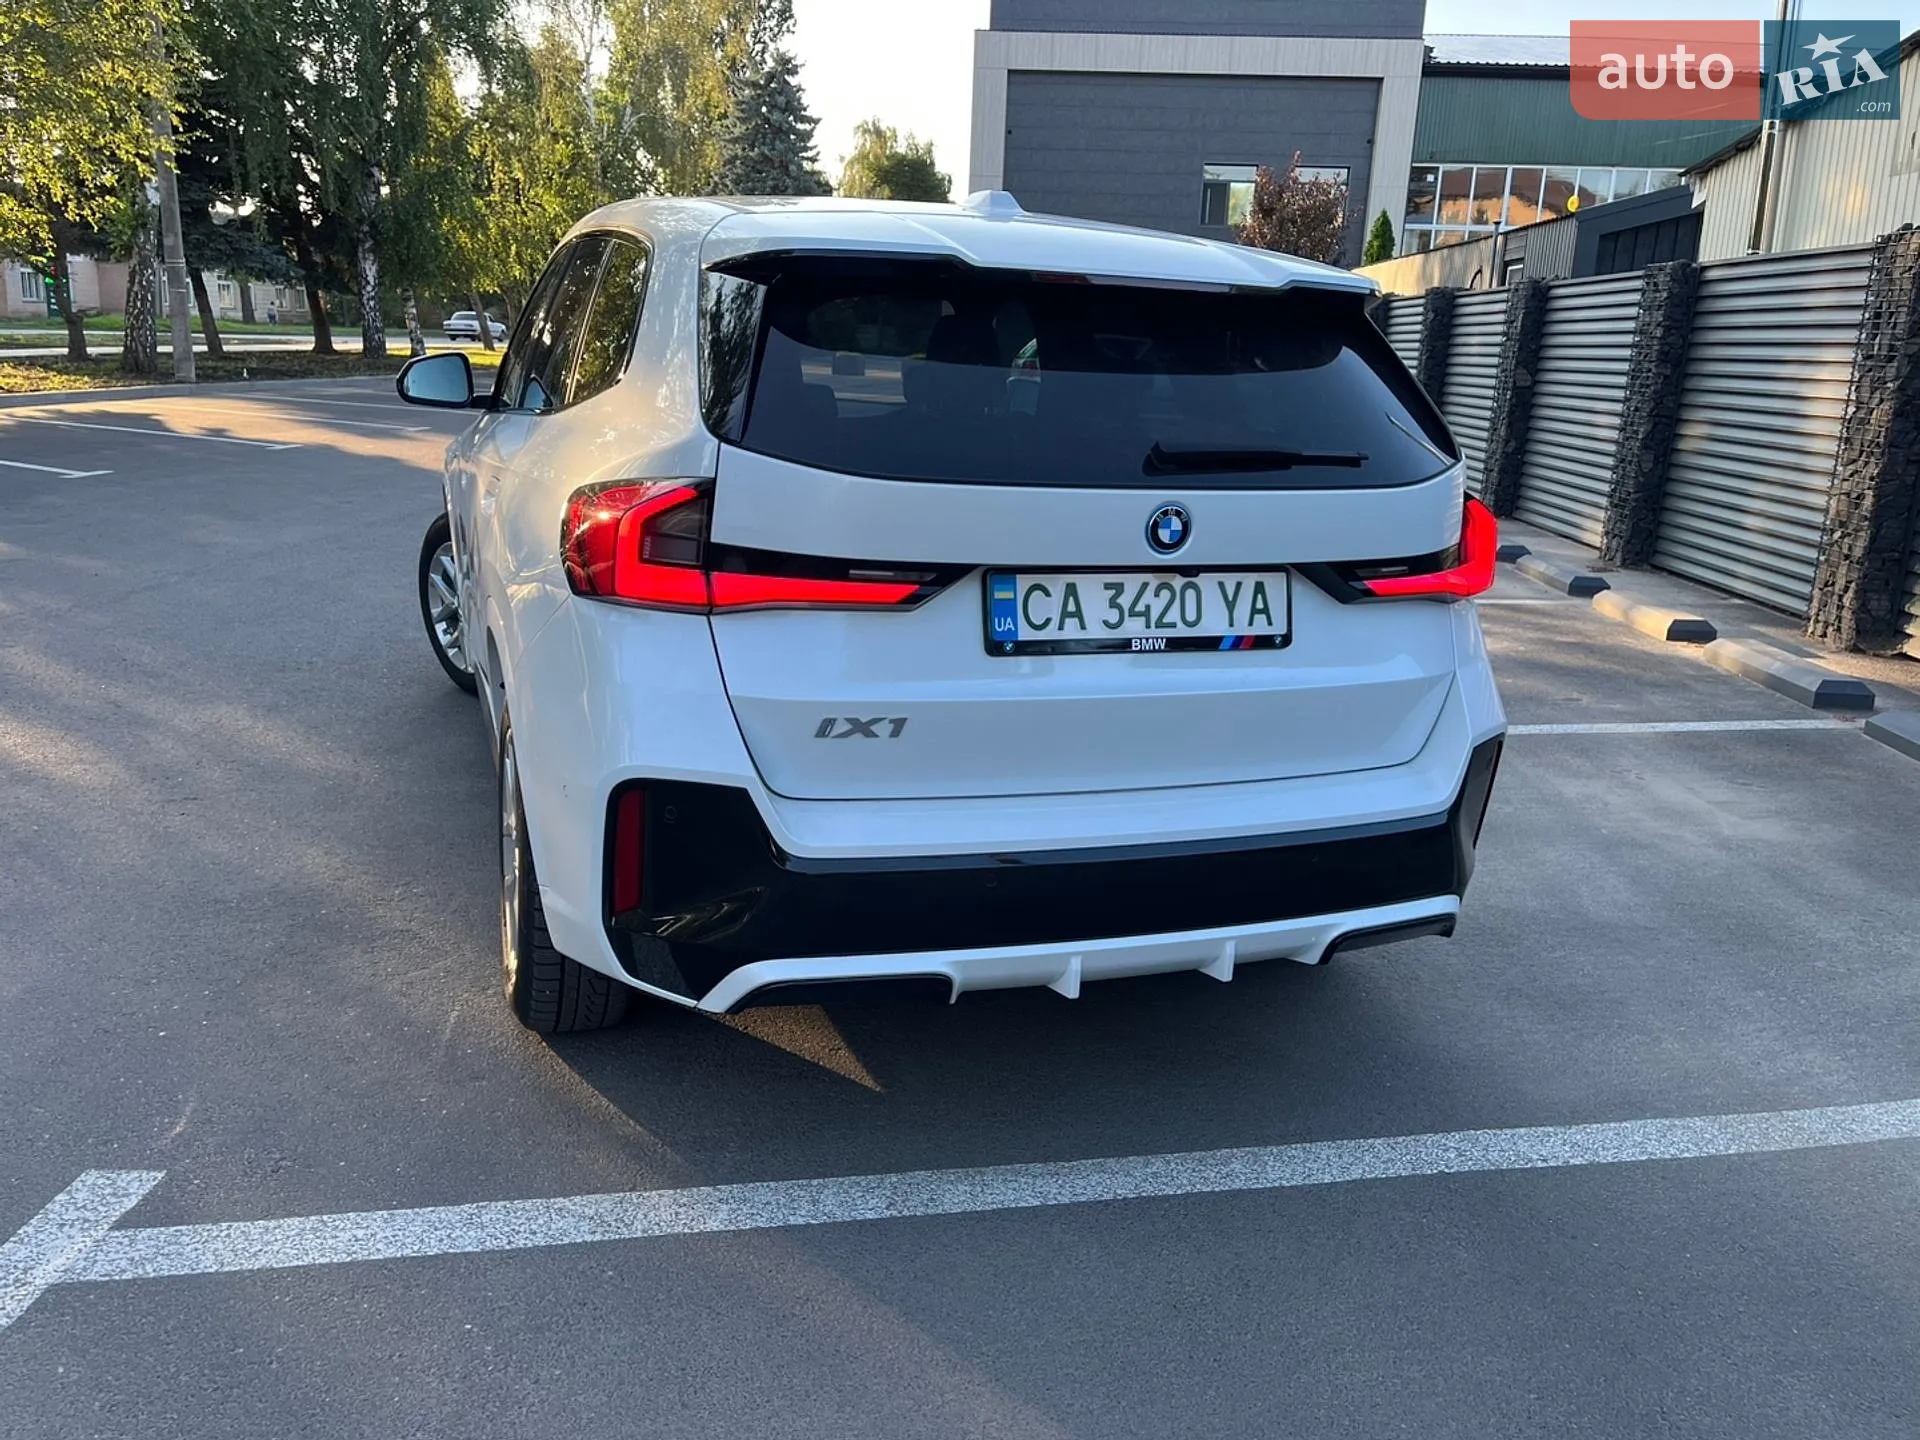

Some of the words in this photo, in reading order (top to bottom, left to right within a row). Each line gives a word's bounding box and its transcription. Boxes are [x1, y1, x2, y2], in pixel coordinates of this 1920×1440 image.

[1022, 582, 1087, 631] CA
[1101, 580, 1203, 629] 3420
[1218, 580, 1274, 628] YA
[994, 616, 1015, 632] UA
[1131, 638, 1167, 651] BMW
